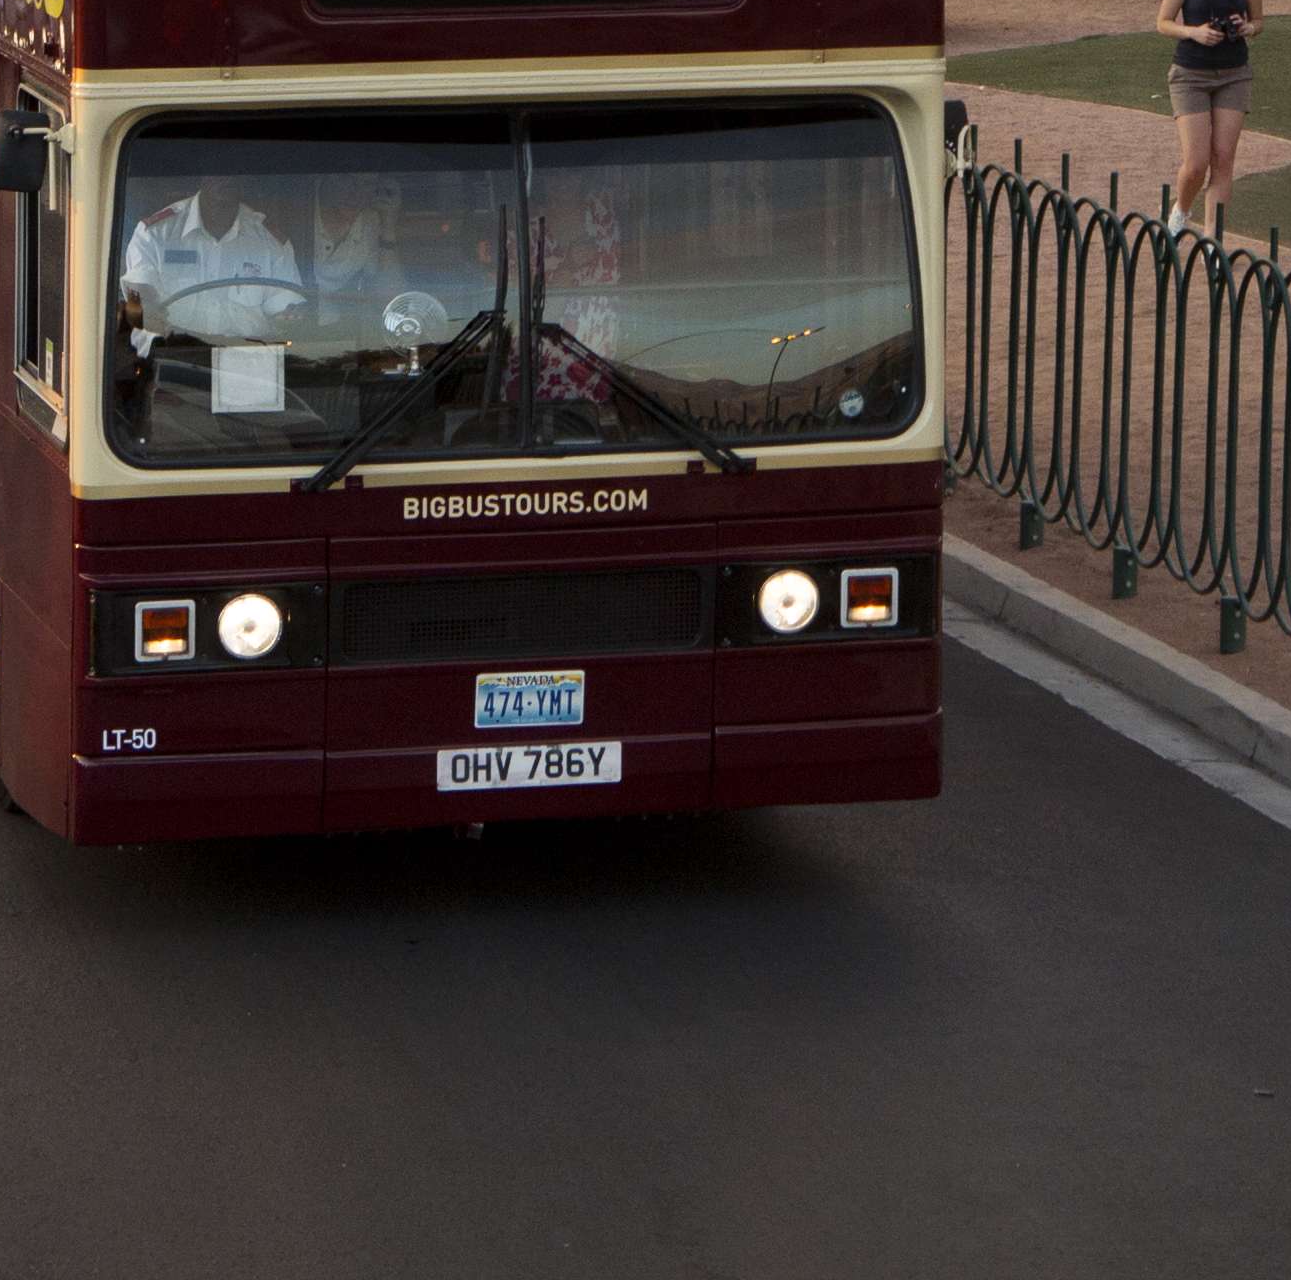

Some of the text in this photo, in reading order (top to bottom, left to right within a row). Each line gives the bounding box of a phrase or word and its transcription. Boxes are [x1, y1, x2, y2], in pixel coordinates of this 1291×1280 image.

[403, 488, 648, 519] BIGBUSTOURS.COM
[507, 675, 556, 687] NEVADA
[102, 728, 157, 750] LT-50
[451, 746, 606, 784] OHV 786Y
